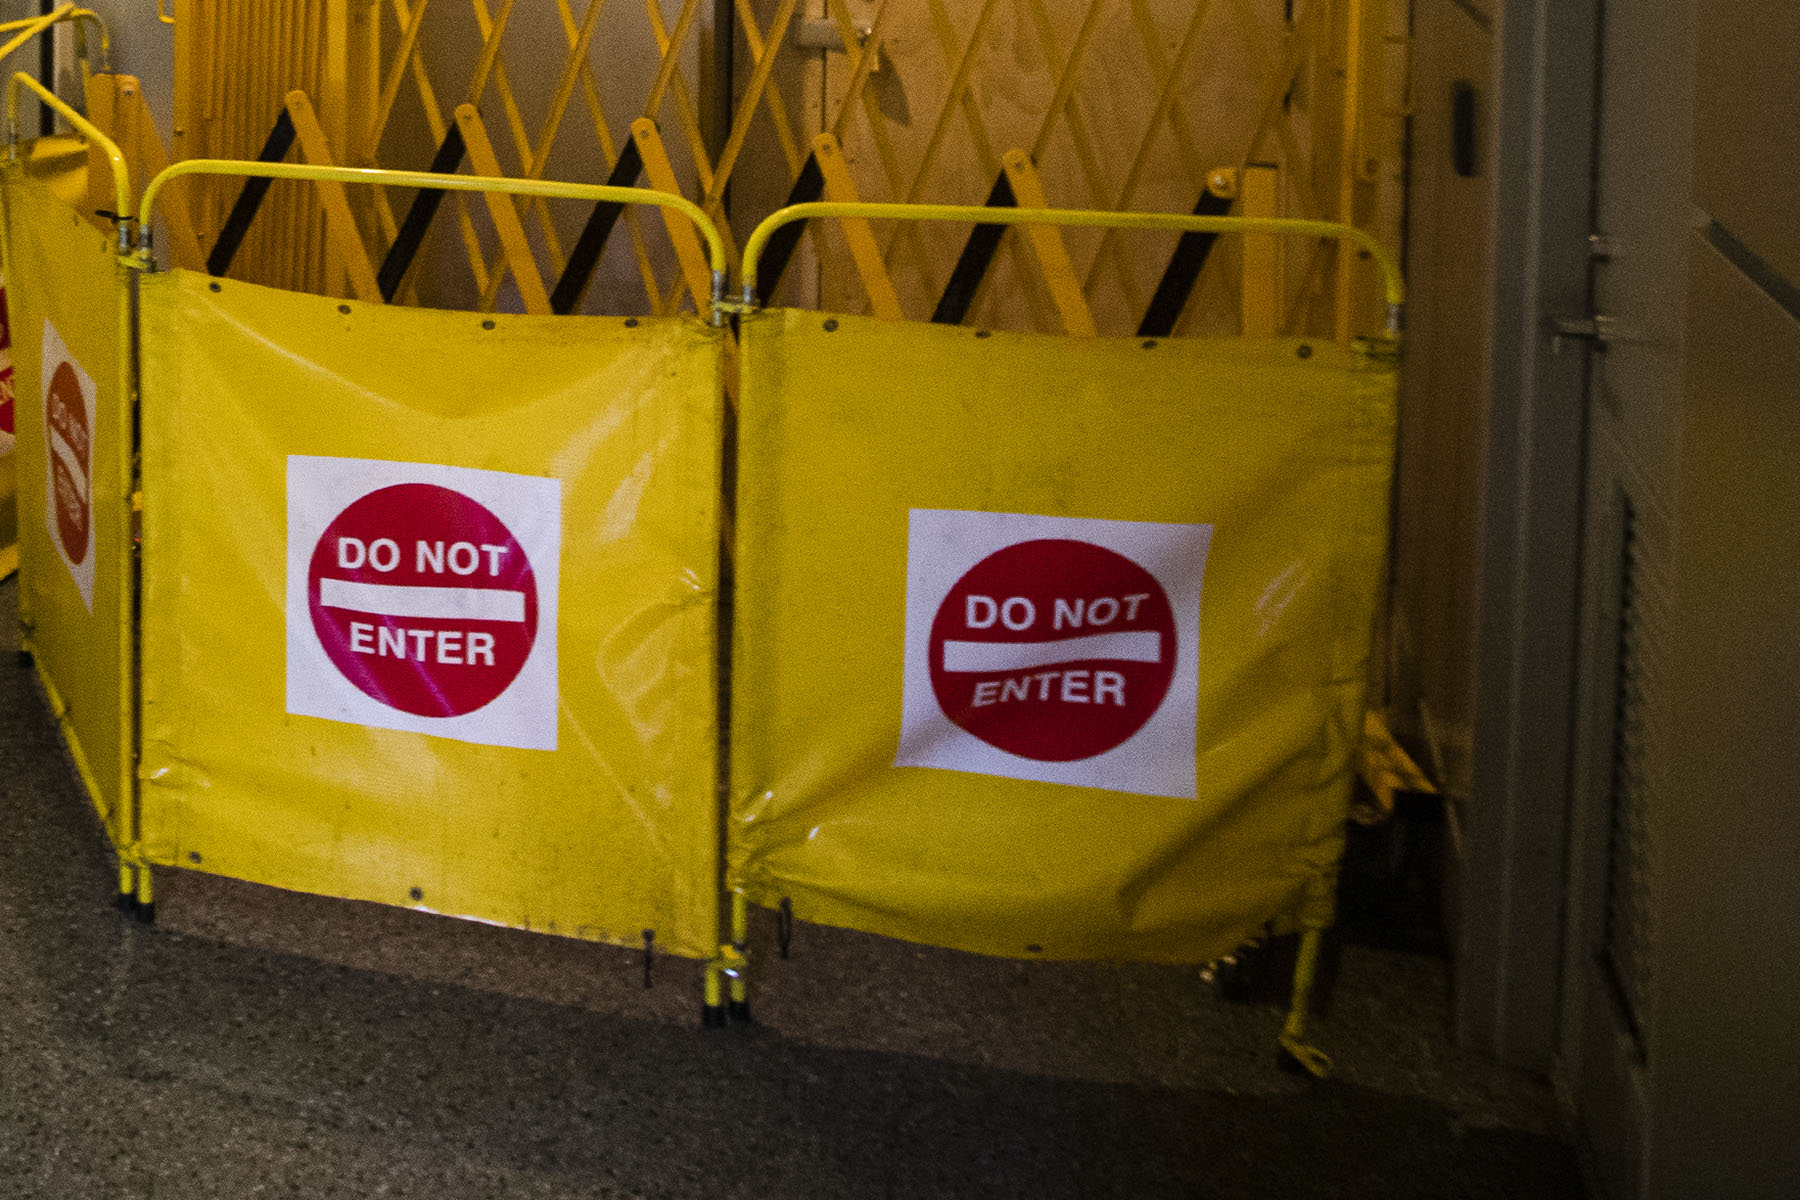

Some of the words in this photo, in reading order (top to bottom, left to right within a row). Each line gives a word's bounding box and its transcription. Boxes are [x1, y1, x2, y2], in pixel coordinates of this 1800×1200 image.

[338, 536, 400, 572] DO
[416, 540, 508, 577] NOT
[965, 594, 1036, 631] DO
[1053, 593, 1149, 631] NOT
[350, 622, 495, 666] ENTER
[972, 670, 1126, 708] ENTER
